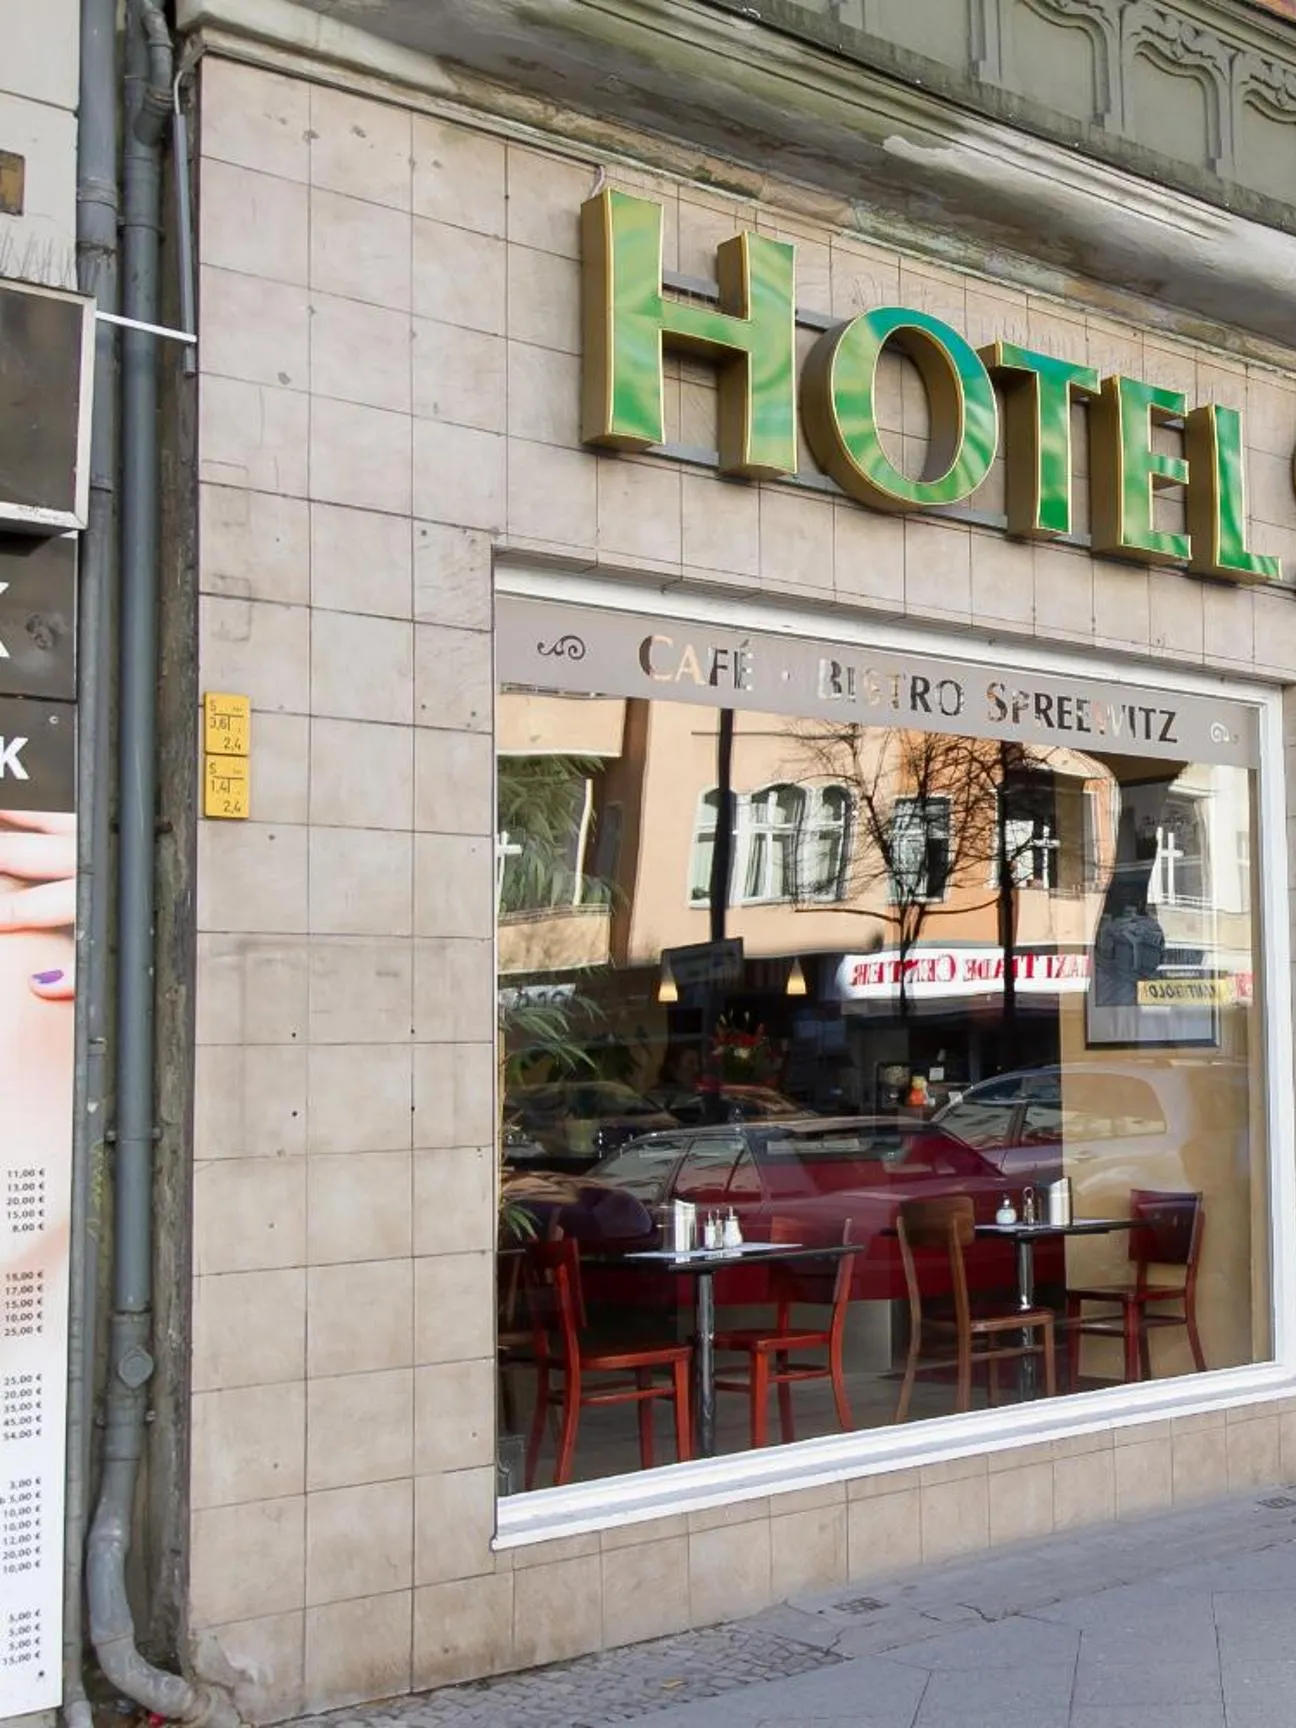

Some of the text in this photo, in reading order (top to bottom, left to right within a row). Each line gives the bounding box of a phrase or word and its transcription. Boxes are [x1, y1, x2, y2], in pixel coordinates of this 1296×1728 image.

[582, 187, 1282, 584] HOTEL
[639, 637, 1179, 744] CAFÉ BISTRO SPREEWITZ
